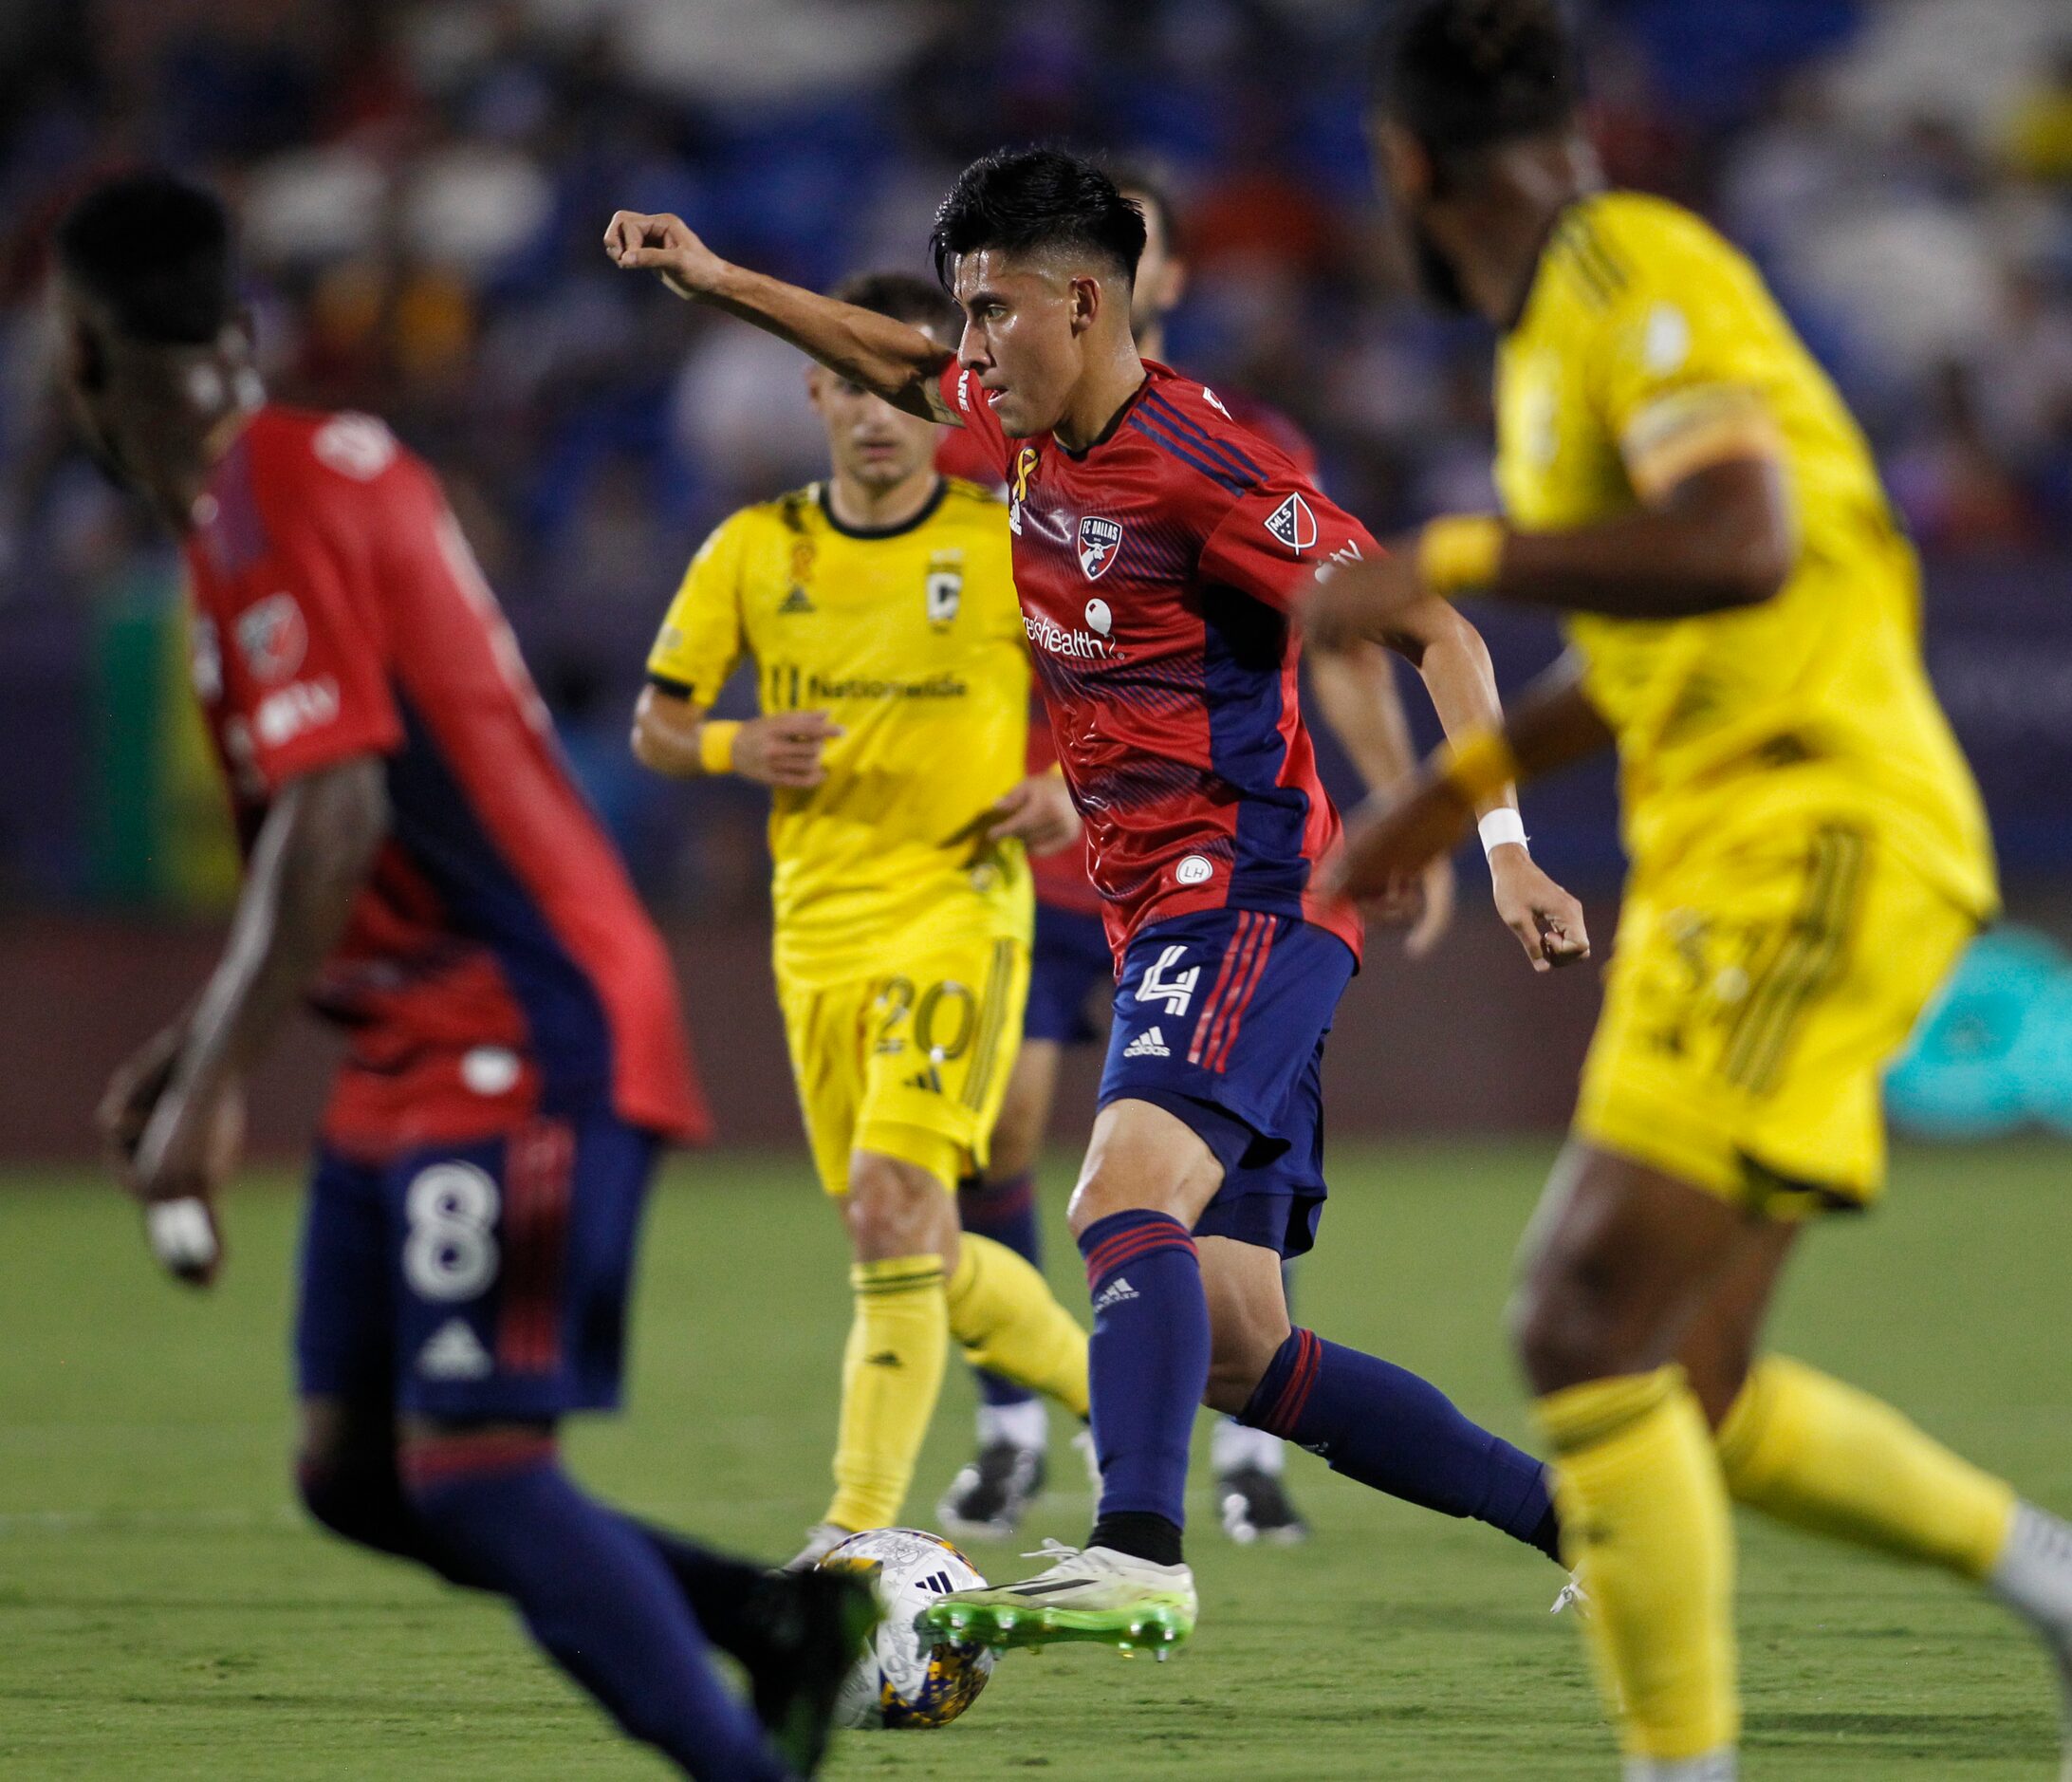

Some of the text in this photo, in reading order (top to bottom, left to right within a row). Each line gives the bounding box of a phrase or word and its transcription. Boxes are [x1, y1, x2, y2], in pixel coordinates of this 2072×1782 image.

[1082, 520, 1119, 542] FC DALLAS
[1269, 508, 1292, 531] MLS
[1184, 865, 1204, 879] LH
[1135, 945, 1200, 1017] 4
[874, 977, 976, 1061] 20
[1122, 1045, 1172, 1058] adidas
[403, 1160, 502, 1304] 8
